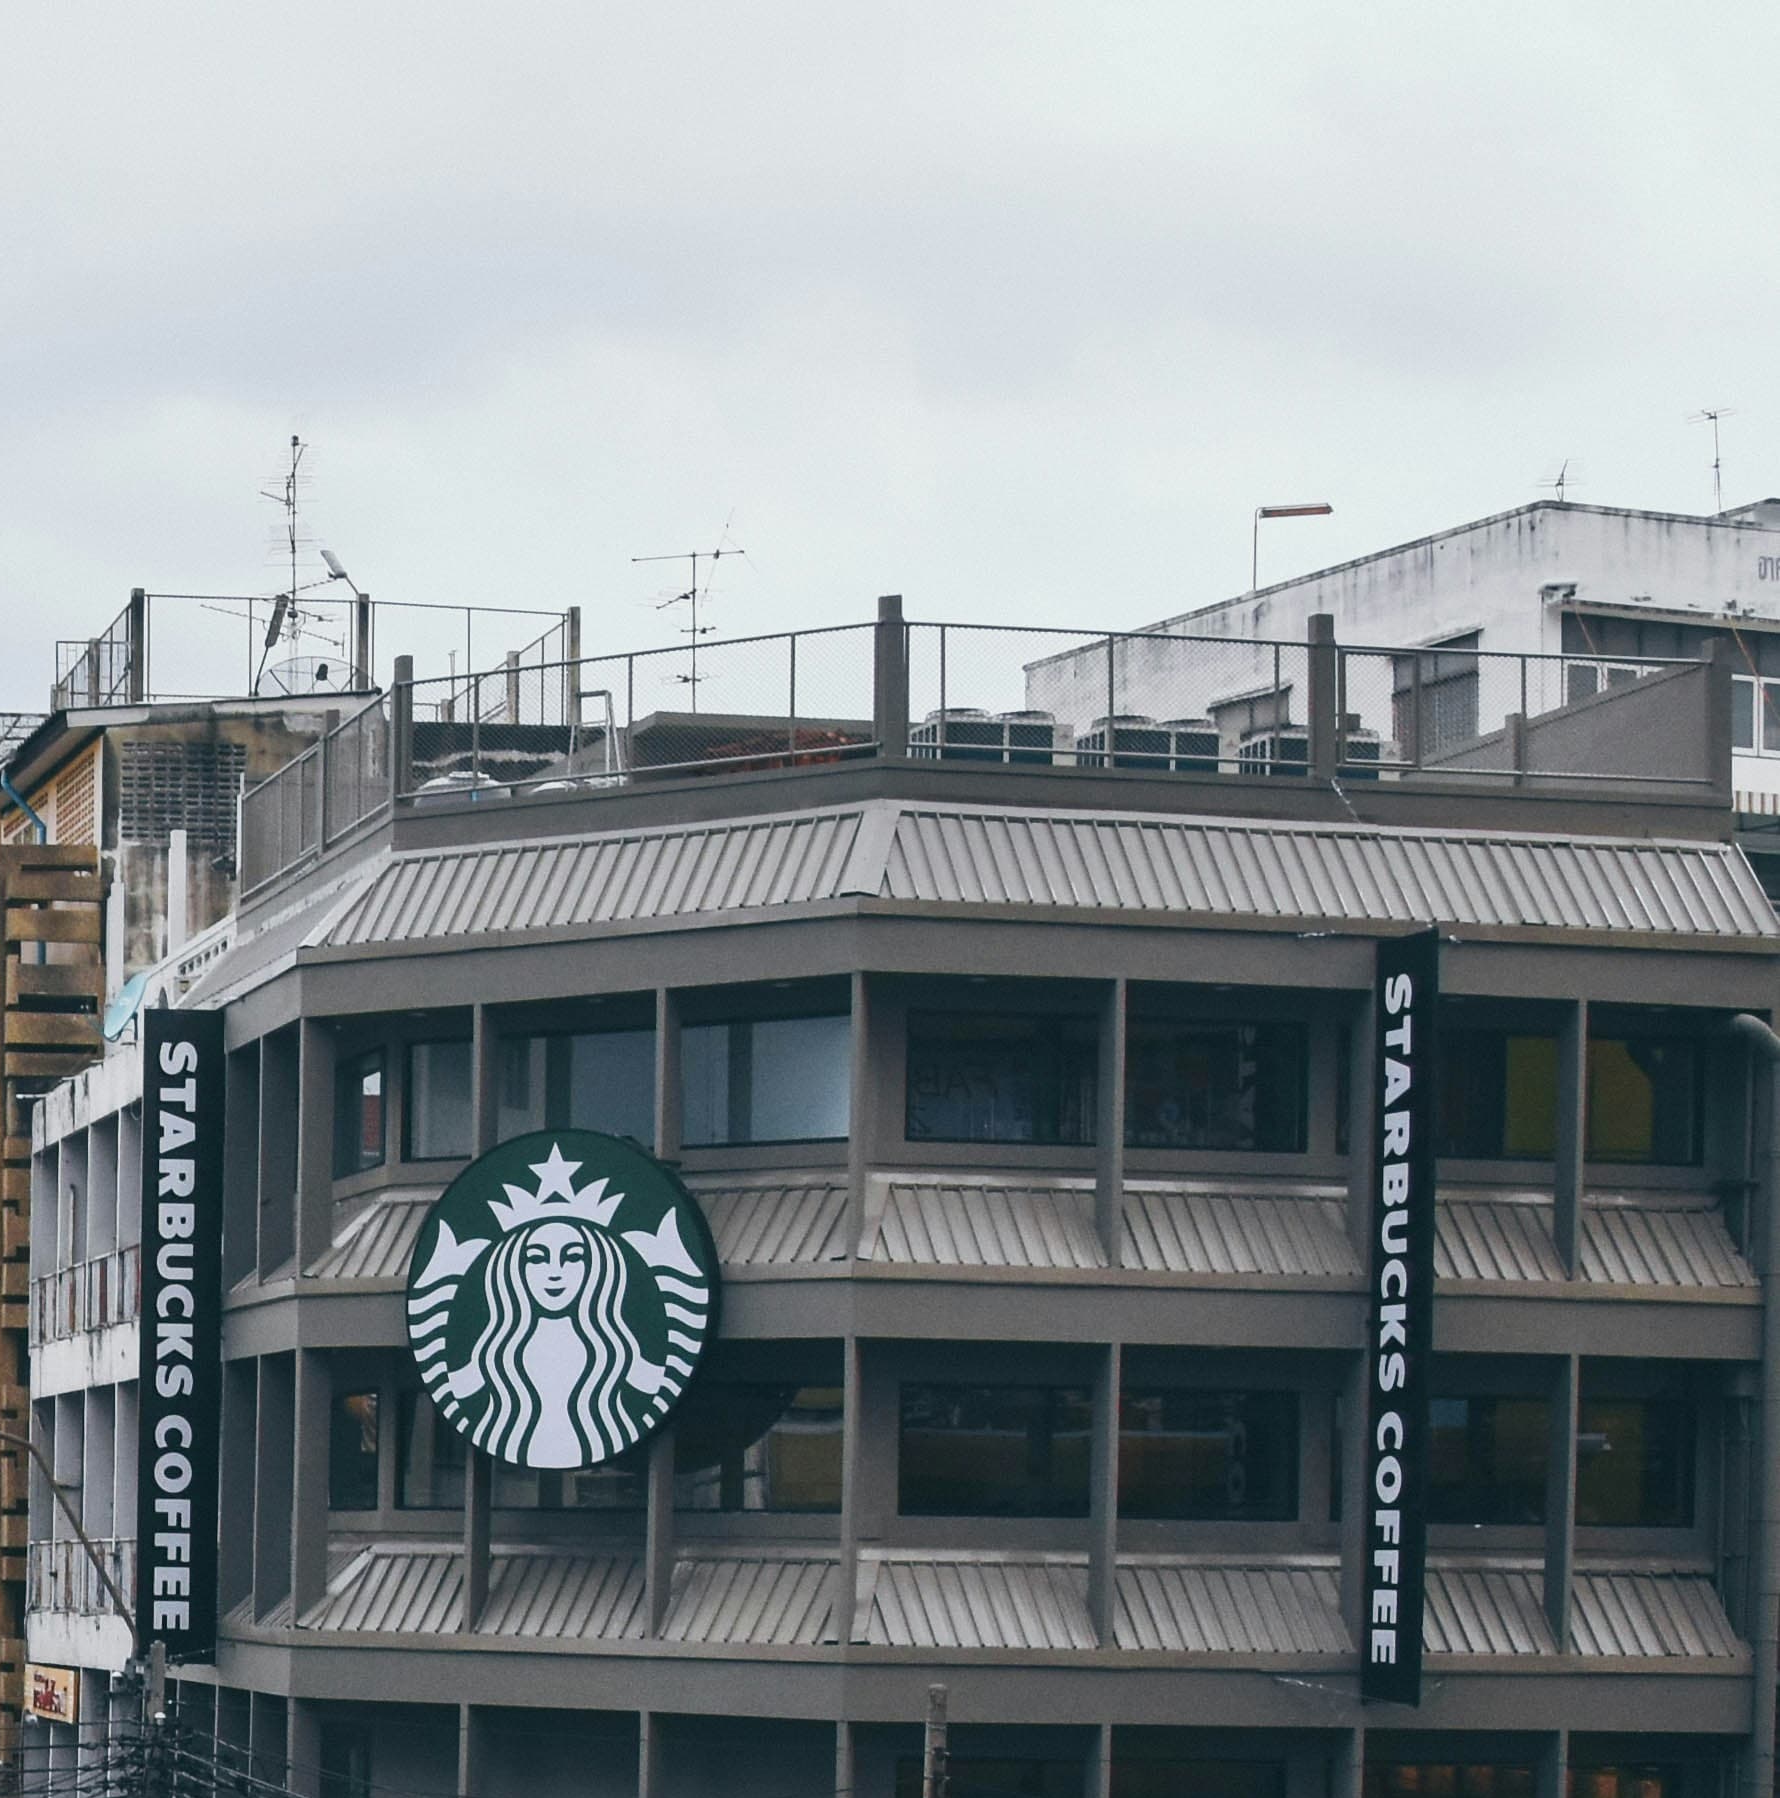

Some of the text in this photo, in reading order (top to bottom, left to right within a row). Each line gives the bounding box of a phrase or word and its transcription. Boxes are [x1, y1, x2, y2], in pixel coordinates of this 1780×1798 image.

[152, 1040, 198, 1632] STARBUCKS COFFEE
[1371, 972, 1413, 1666] STARBUCKS COFFEE
